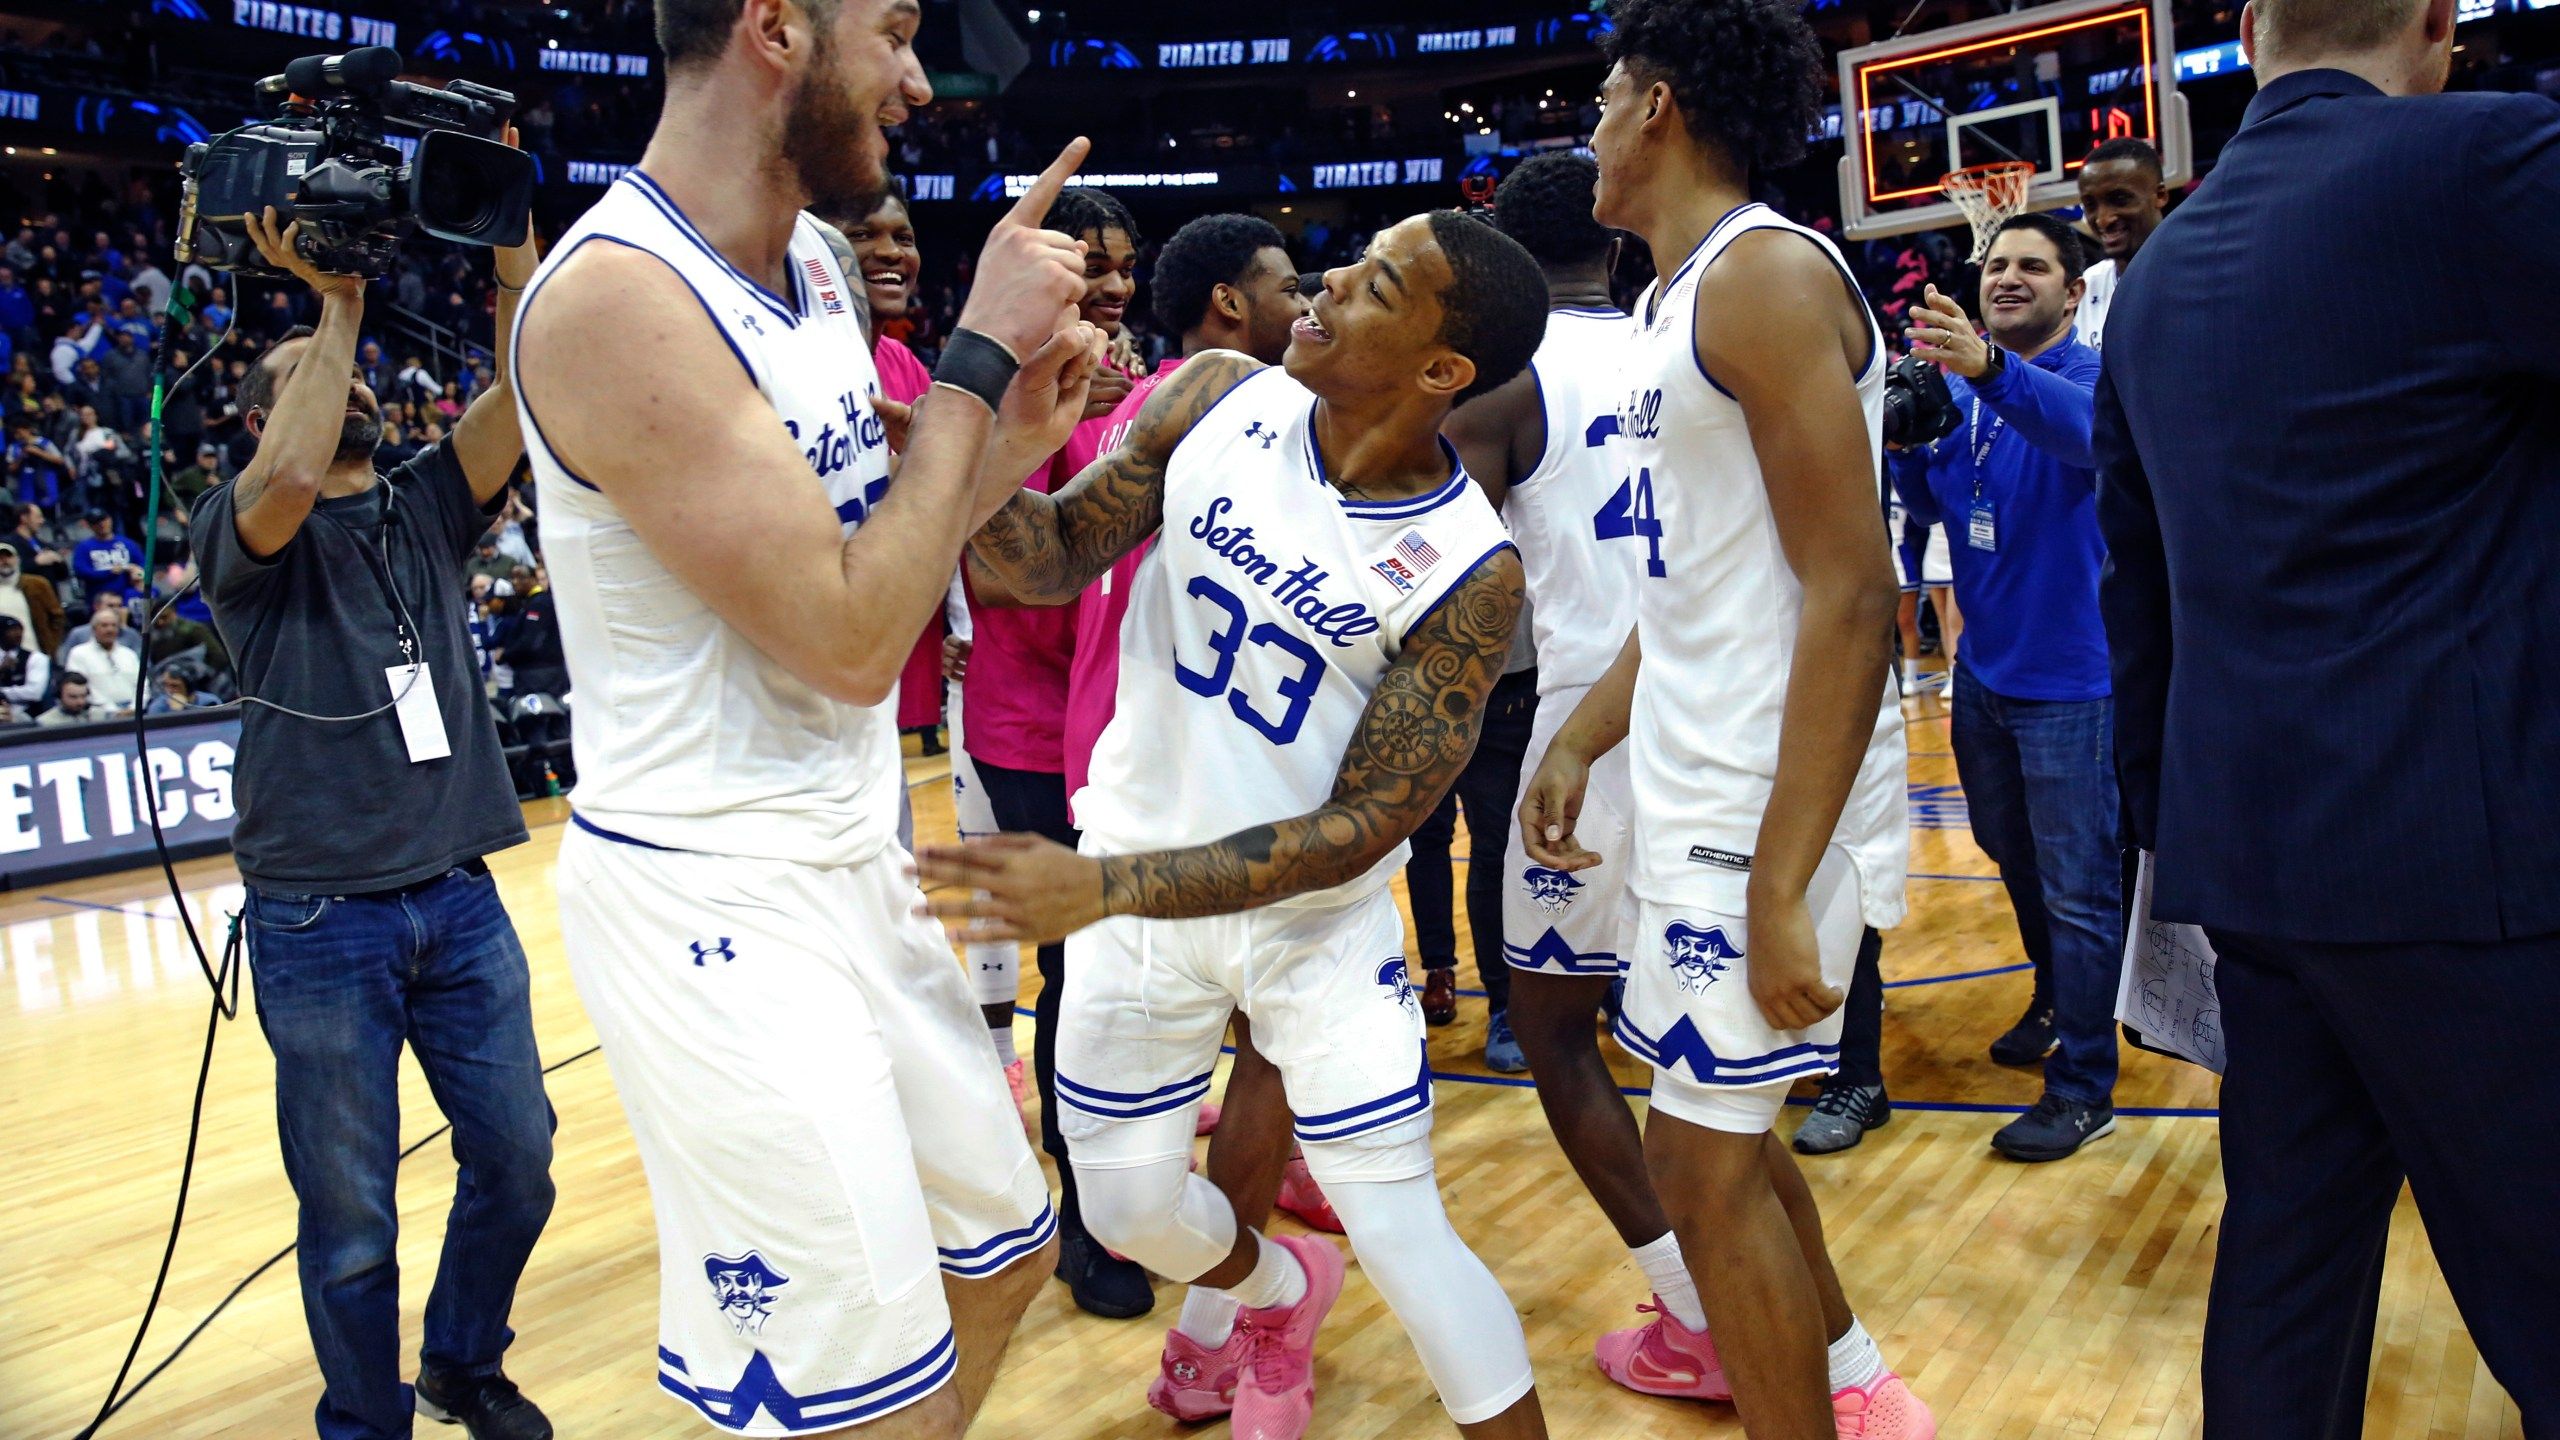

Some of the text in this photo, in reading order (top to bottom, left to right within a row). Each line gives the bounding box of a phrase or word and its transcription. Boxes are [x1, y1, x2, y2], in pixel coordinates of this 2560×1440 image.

[233, 0, 397, 49] PIRATES WIN
[1158, 38, 1290, 68] PIRATES WIN
[1417, 29, 1481, 52] PIRATES
[539, 48, 611, 73] PIRATES
[1313, 158, 1443, 188] PIRATES WIN
[1190, 496, 1380, 648] Seton Hall
[1376, 561, 1414, 590] EAST
[1386, 557, 1415, 579] BIG
[1174, 575, 1327, 746] 33
[0, 740, 237, 855] ETICS
[1692, 848, 1745, 864] AUTHENTIC
